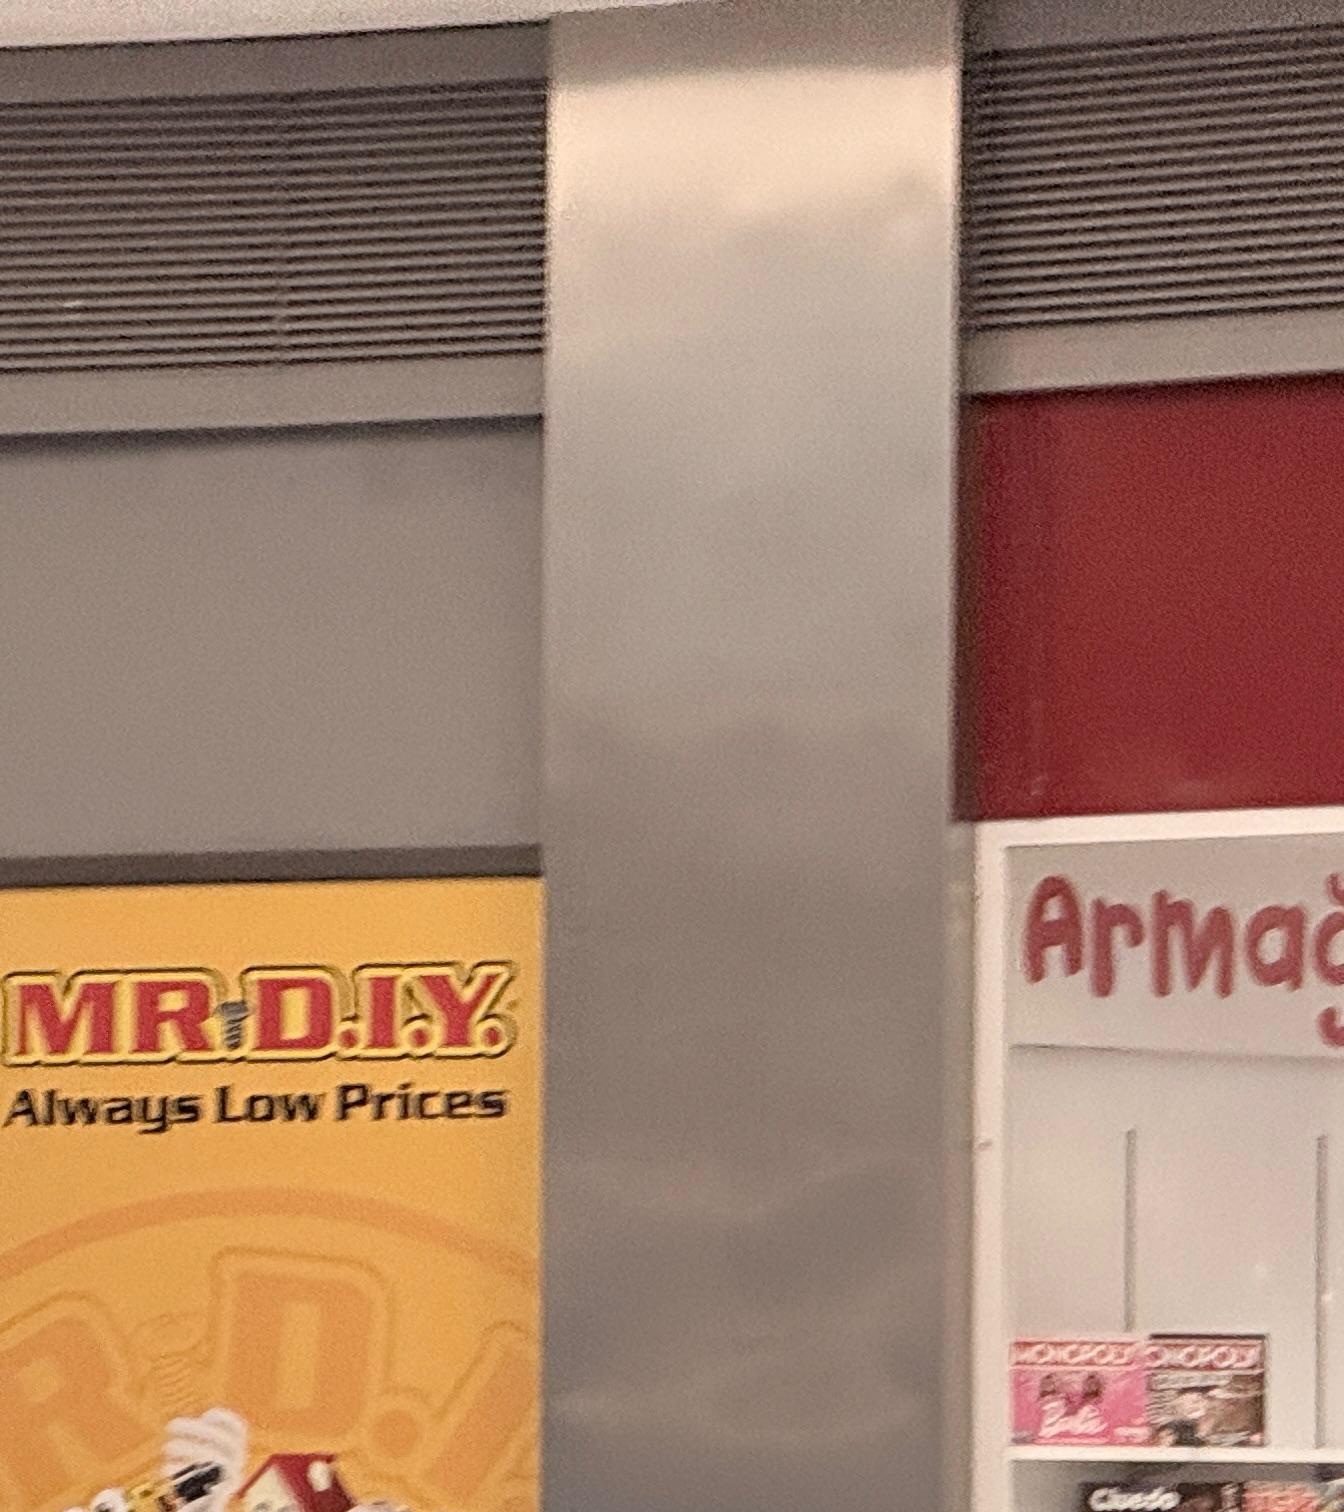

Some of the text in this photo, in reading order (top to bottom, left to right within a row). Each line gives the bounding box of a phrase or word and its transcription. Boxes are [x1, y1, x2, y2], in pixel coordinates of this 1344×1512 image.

[3, 1081, 510, 1135] Always Low Prices
